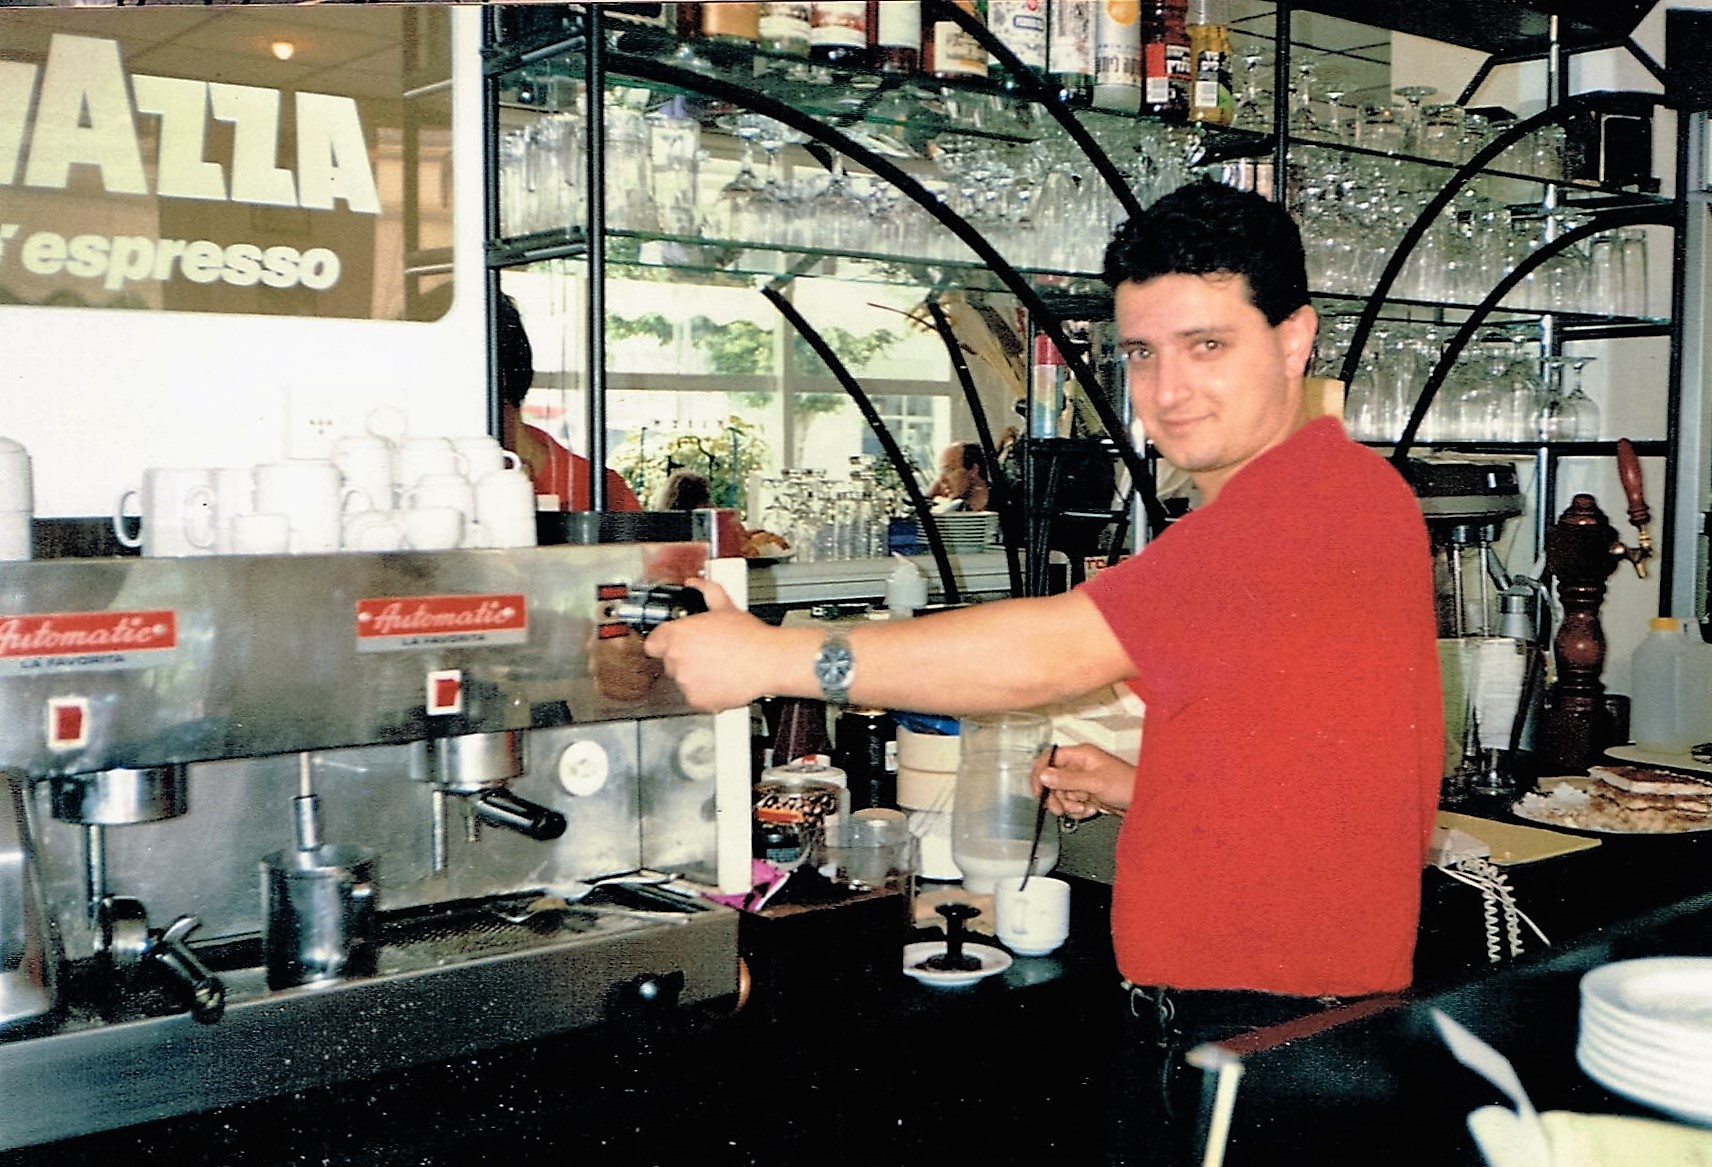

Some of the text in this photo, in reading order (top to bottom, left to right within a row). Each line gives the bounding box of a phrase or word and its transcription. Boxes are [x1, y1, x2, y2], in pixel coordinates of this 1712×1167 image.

[21, 231, 341, 290] espresso
[0, 616, 154, 650] Automatic
[373, 600, 511, 634] Automatic
[20, 658, 42, 669] LA
